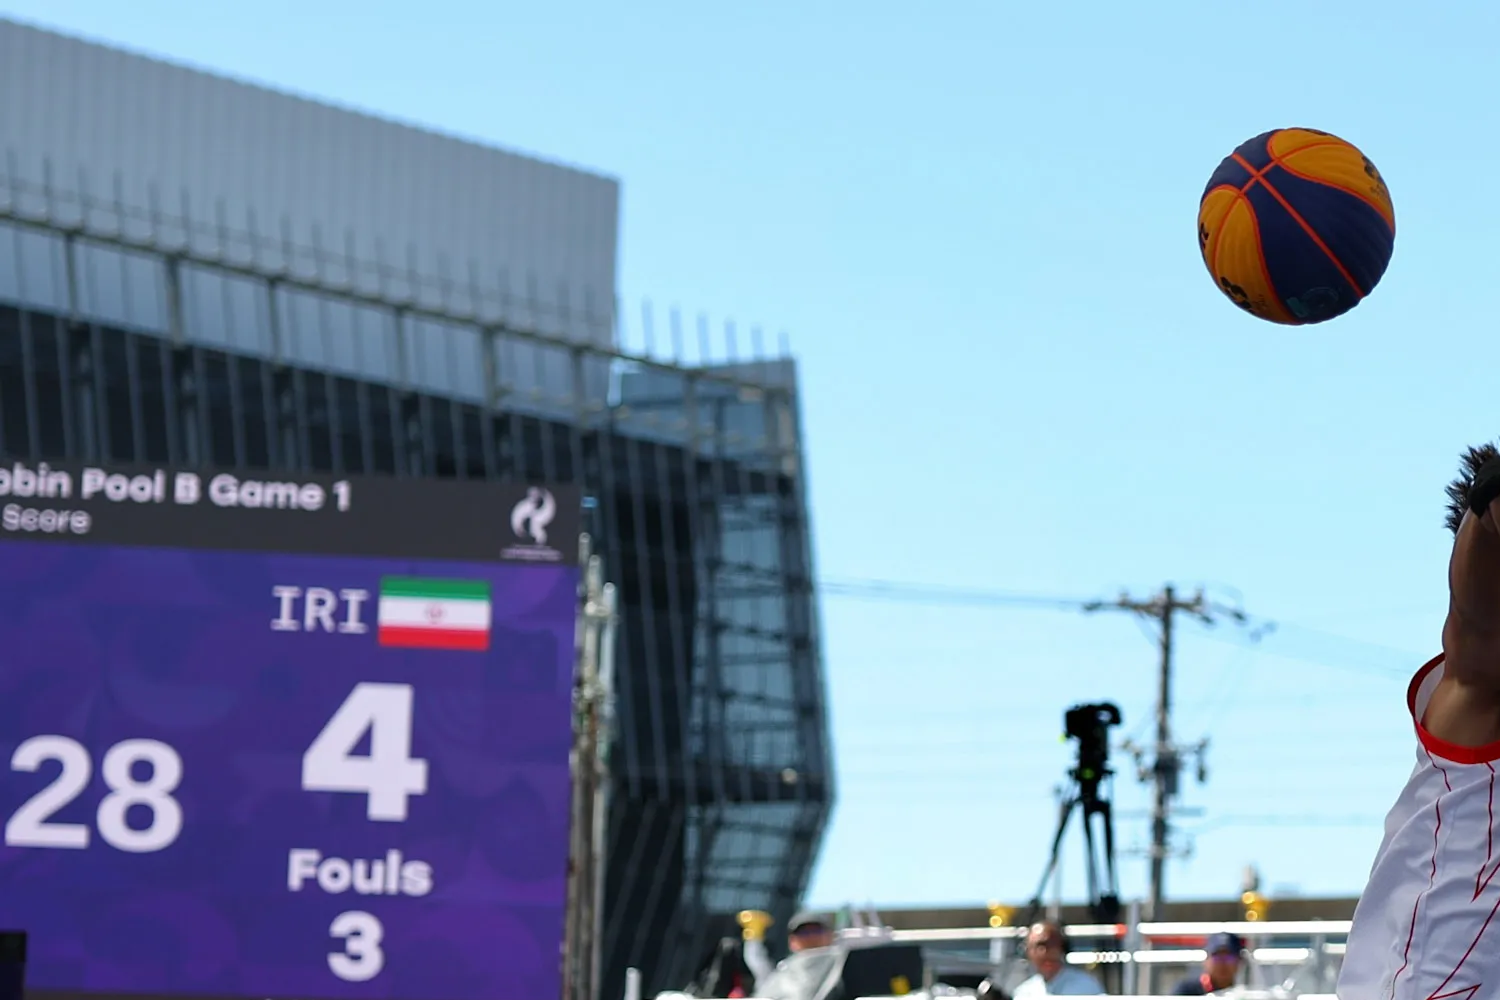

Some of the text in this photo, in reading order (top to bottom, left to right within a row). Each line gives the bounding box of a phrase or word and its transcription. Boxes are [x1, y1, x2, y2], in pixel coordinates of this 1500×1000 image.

[81, 467, 166, 503] Pool
[174, 472, 201, 505] B
[208, 473, 327, 511] Game
[332, 480, 351, 512] 1
[2, 503, 92, 534] Score
[271, 586, 369, 633] IRI
[301, 682, 429, 822] 4
[4, 735, 184, 852] 28
[287, 849, 433, 896] Fouls
[327, 910, 385, 981] 3
